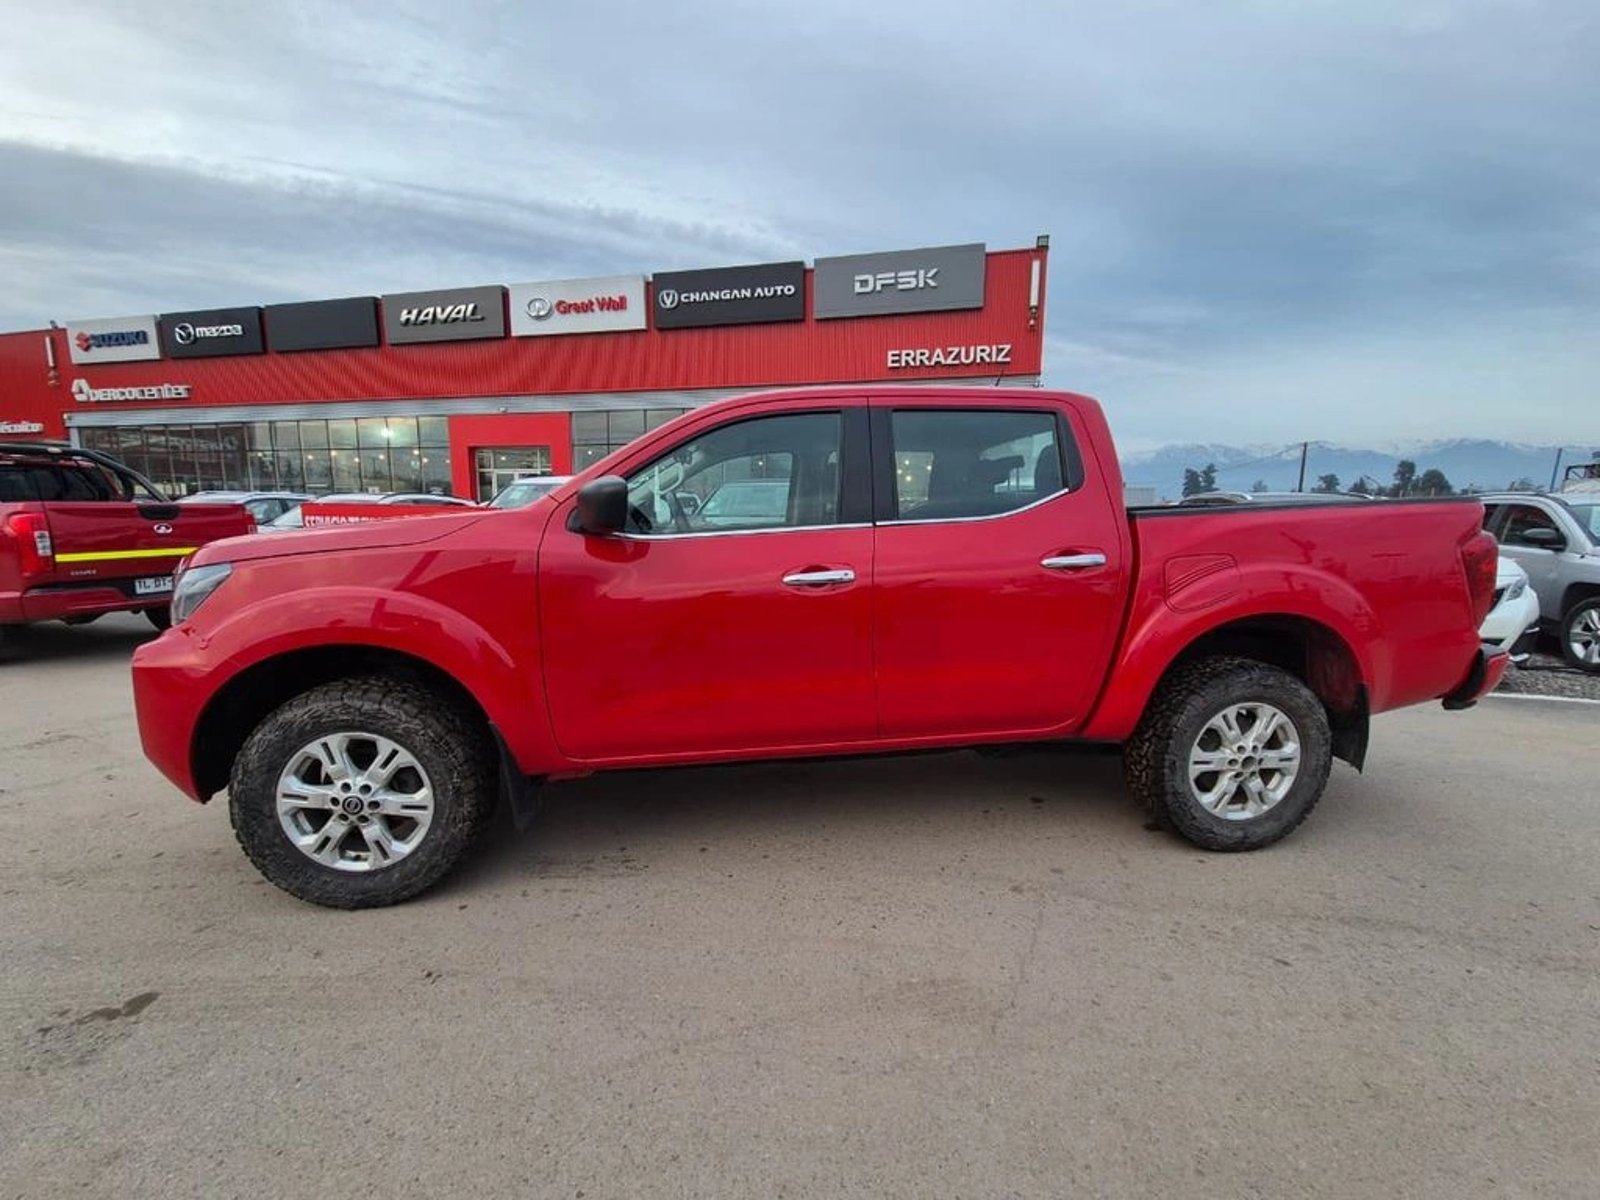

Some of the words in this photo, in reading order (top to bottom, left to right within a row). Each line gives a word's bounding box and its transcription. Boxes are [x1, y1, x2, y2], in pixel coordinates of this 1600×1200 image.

[853, 267, 938, 294] DFSK
[679, 288, 751, 304] CHANGAN
[753, 284, 795, 299] AUTO
[400, 303, 486, 326] HAVAL
[555, 299, 595, 315] Great
[597, 295, 628, 312] Wall
[90, 330, 149, 347] SUZUKI
[887, 344, 1012, 369] ERRAZURIZ
